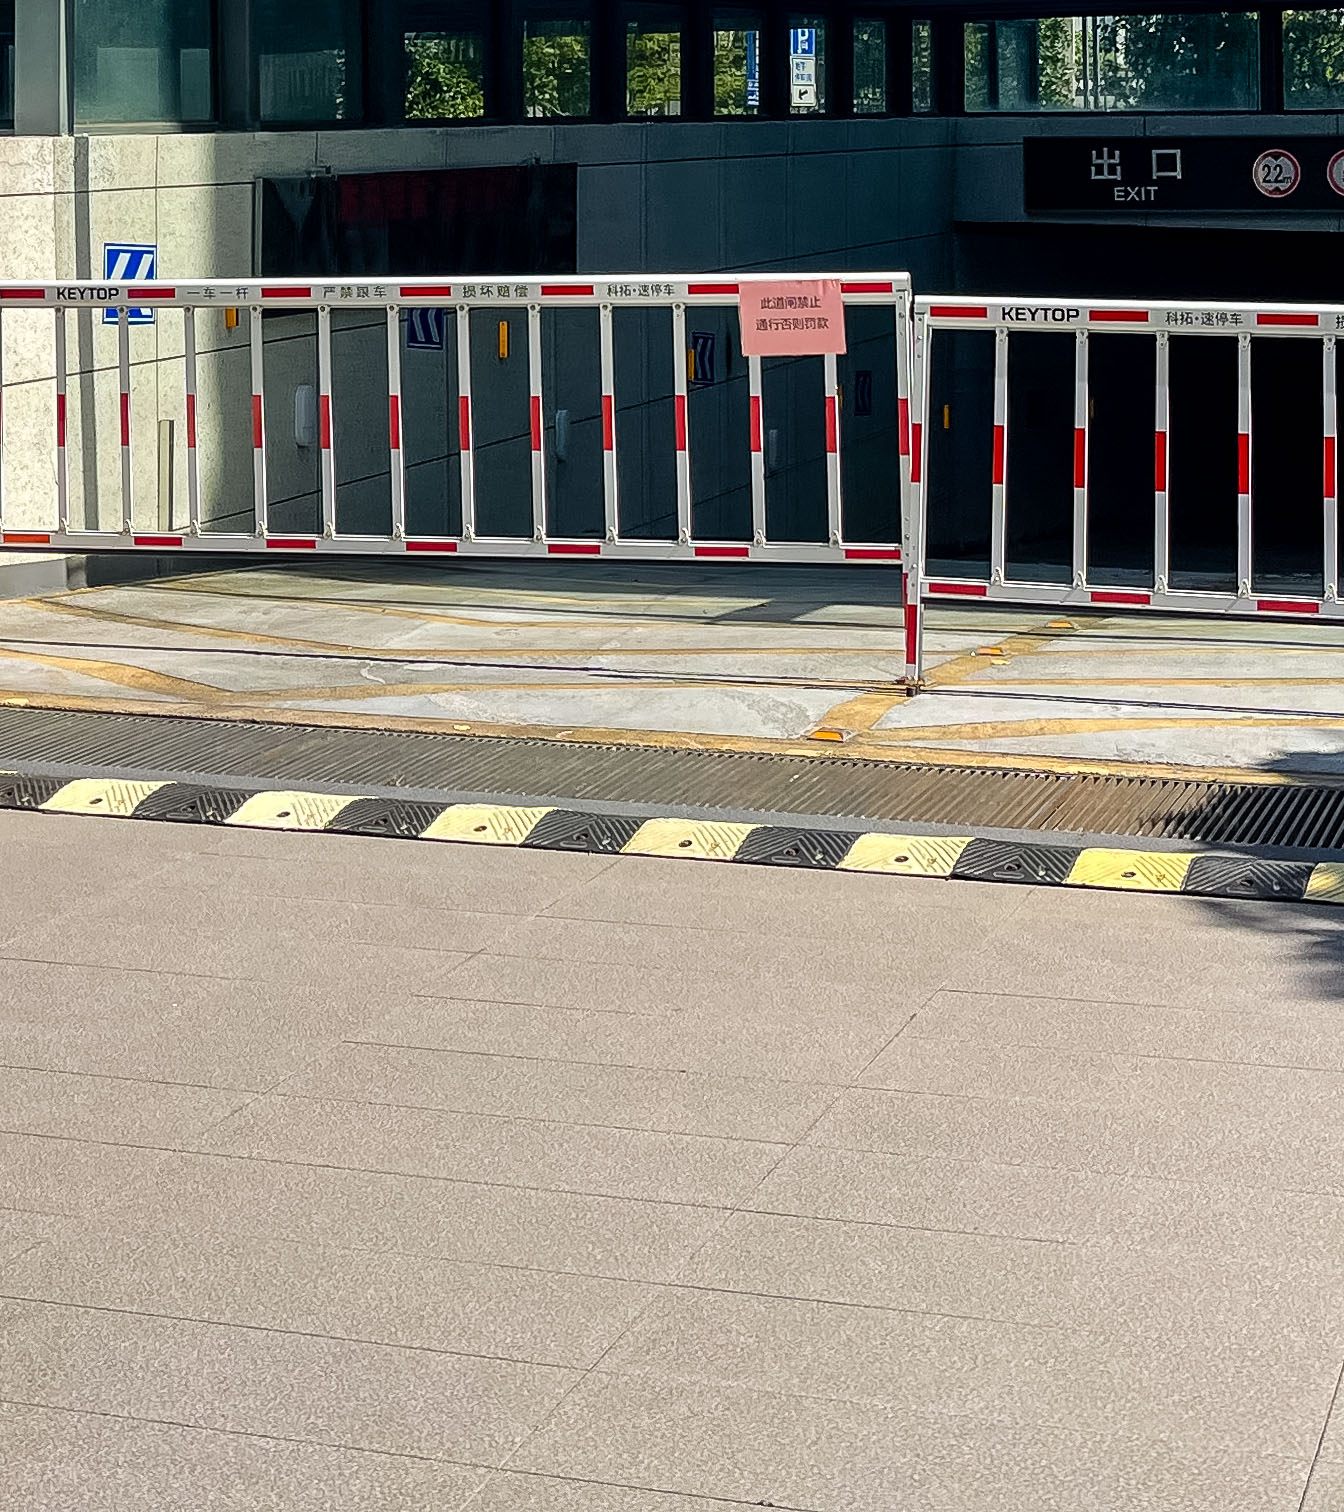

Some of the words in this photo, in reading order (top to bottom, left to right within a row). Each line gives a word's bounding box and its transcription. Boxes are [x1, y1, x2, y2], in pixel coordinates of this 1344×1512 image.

[1091, 147, 1181, 180] 出口
[1114, 187, 1158, 201] EXIT
[56, 287, 119, 301] KEYTOP
[187, 287, 249, 300] 一车一杆
[323, 286, 387, 299] 严禁跟车
[462, 285, 529, 299] 损坏赔偿
[1001, 307, 1080, 322] KEYTOP
